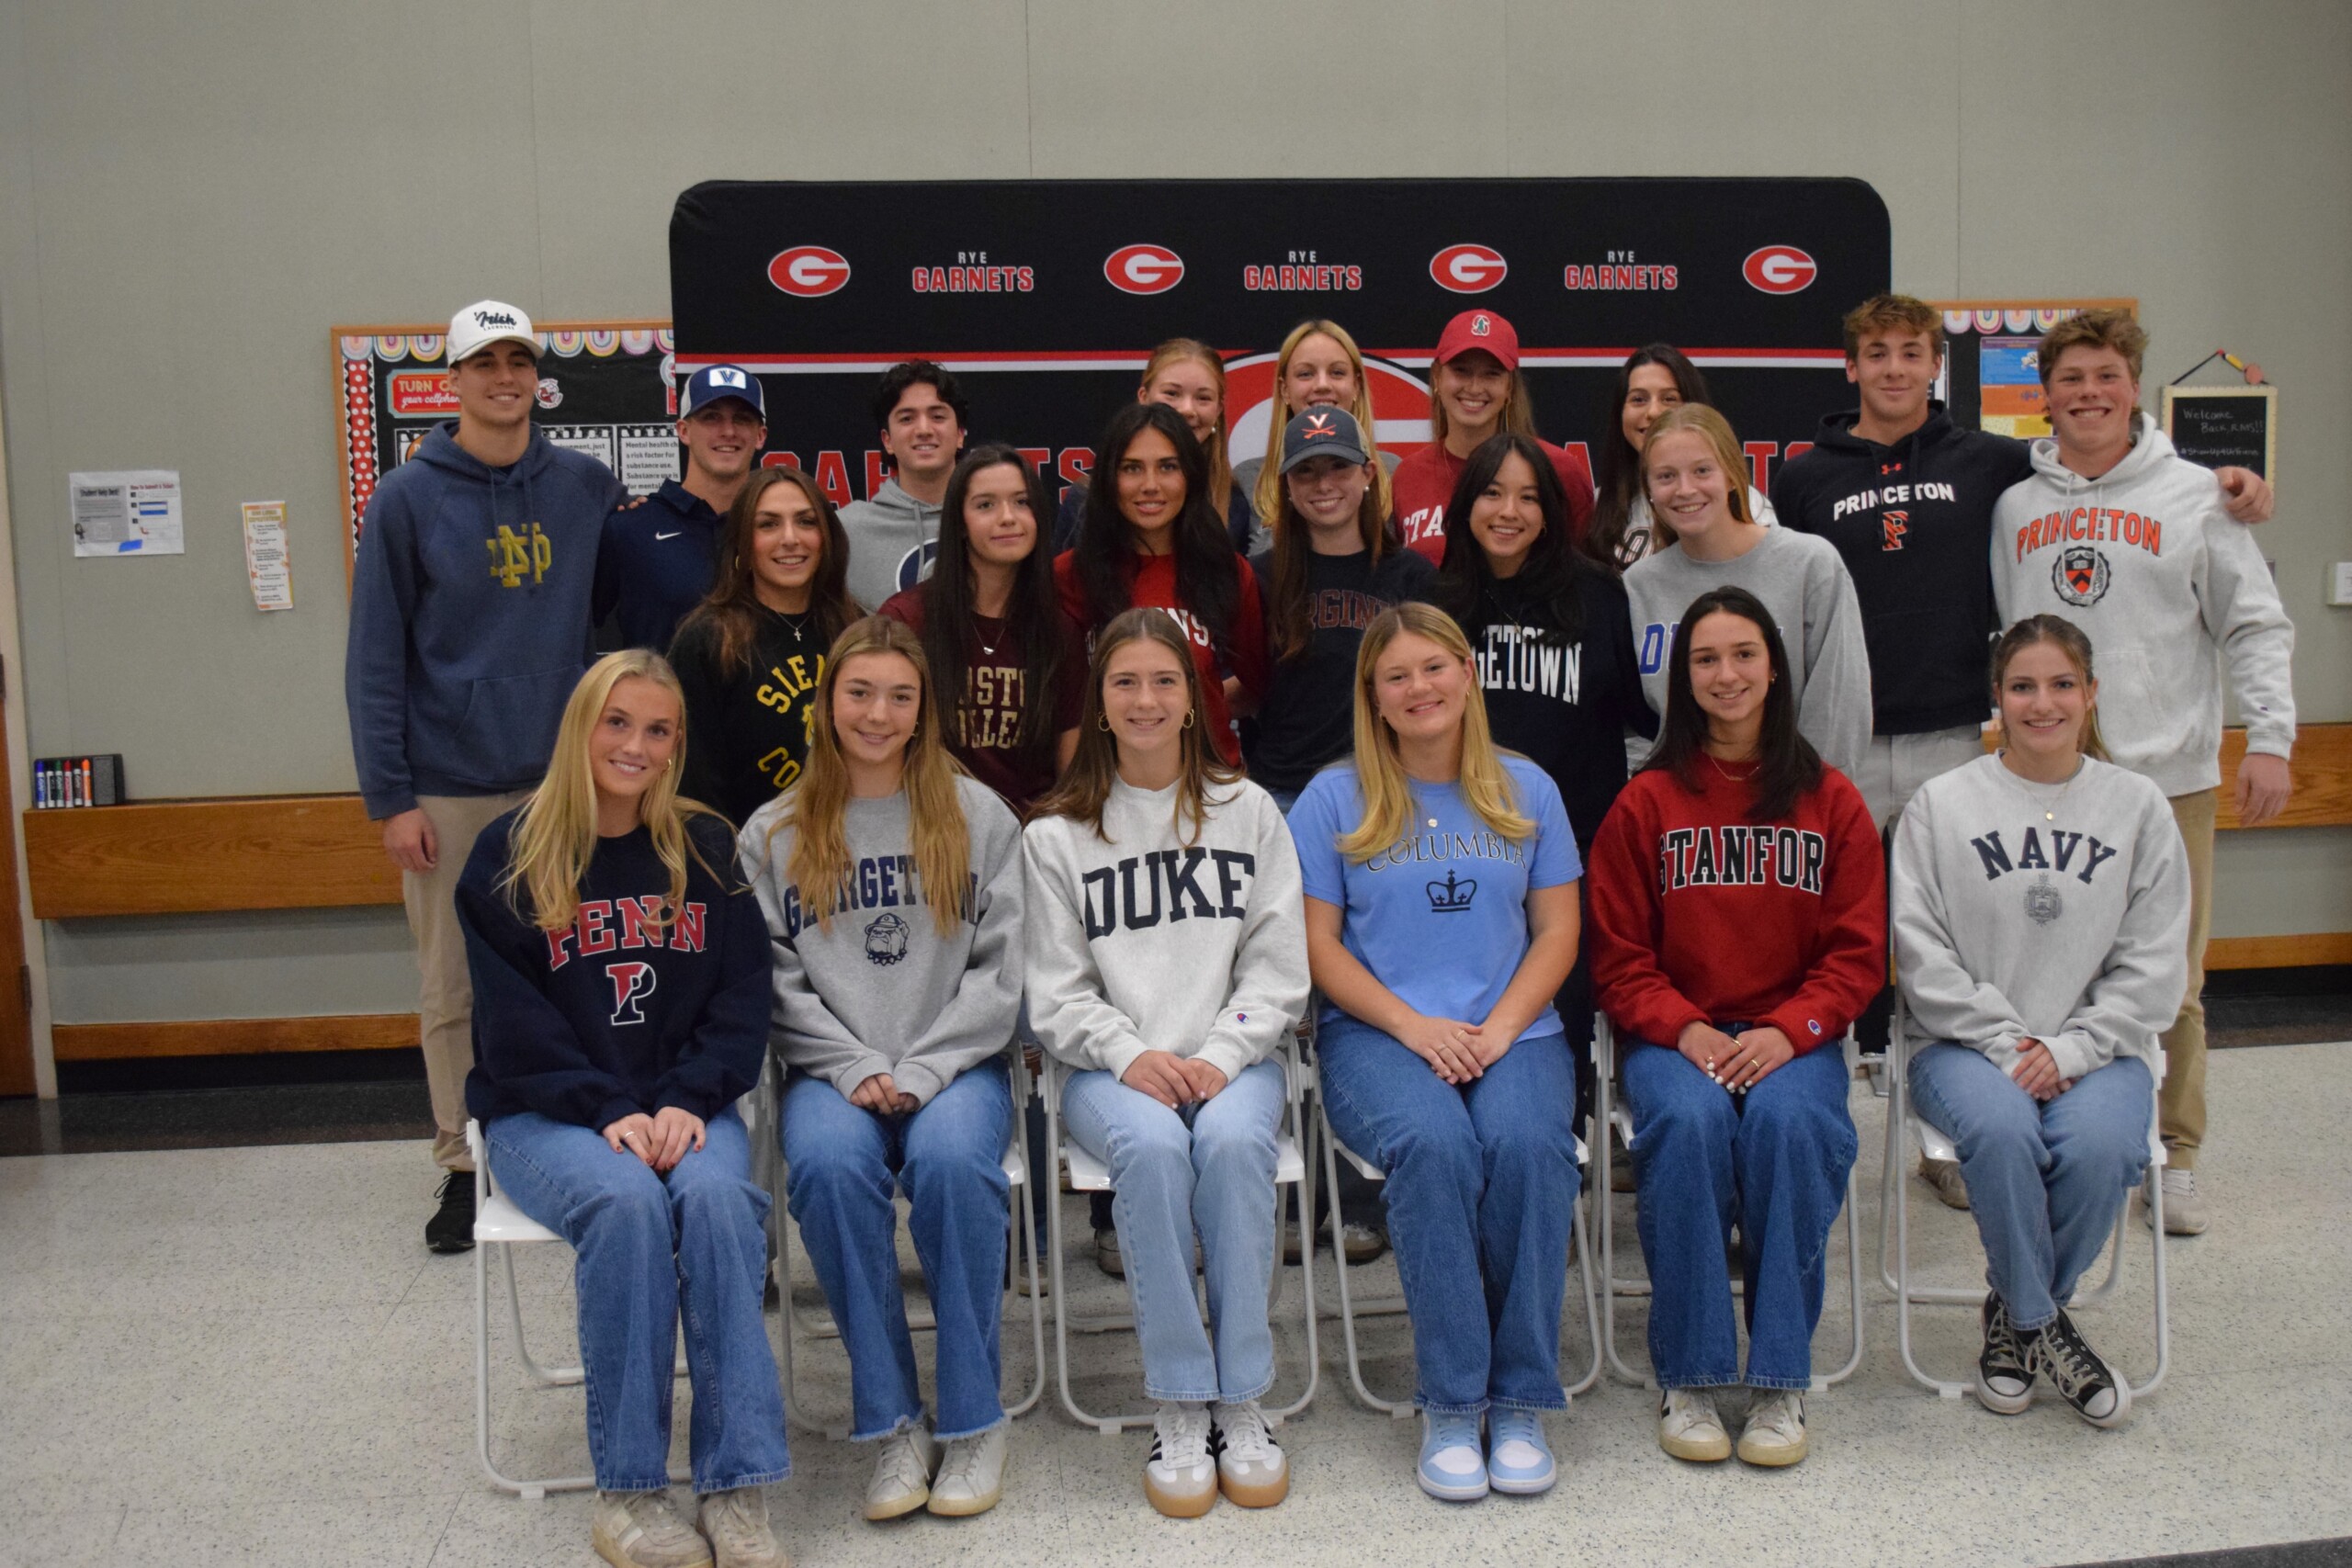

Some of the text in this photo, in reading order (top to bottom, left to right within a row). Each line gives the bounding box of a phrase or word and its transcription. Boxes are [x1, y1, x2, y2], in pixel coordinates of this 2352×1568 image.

[957, 251, 988, 265] RYE
[1288, 251, 1317, 264] RYE
[1607, 251, 1635, 263] RYE
[912, 266, 1034, 293] GARNETS
[1244, 265, 1362, 291] GARNETS
[1565, 265, 1678, 290] GARNETS
[398, 379, 433, 393] TURN
[401, 392, 460, 410] your cellphon
[1307, 412, 1329, 429] V
[2183, 408, 2233, 421] Welcome
[626, 441, 648, 449] Mental
[1833, 482, 1956, 522] PRINCETON
[1883, 510, 1909, 551] P
[2017, 507, 2162, 565] PRINCETON
[1970, 826, 2117, 885] NAVY
[1081, 846, 1256, 942] DUKE
[546, 895, 707, 972] PENN
[605, 961, 657, 1026] P
